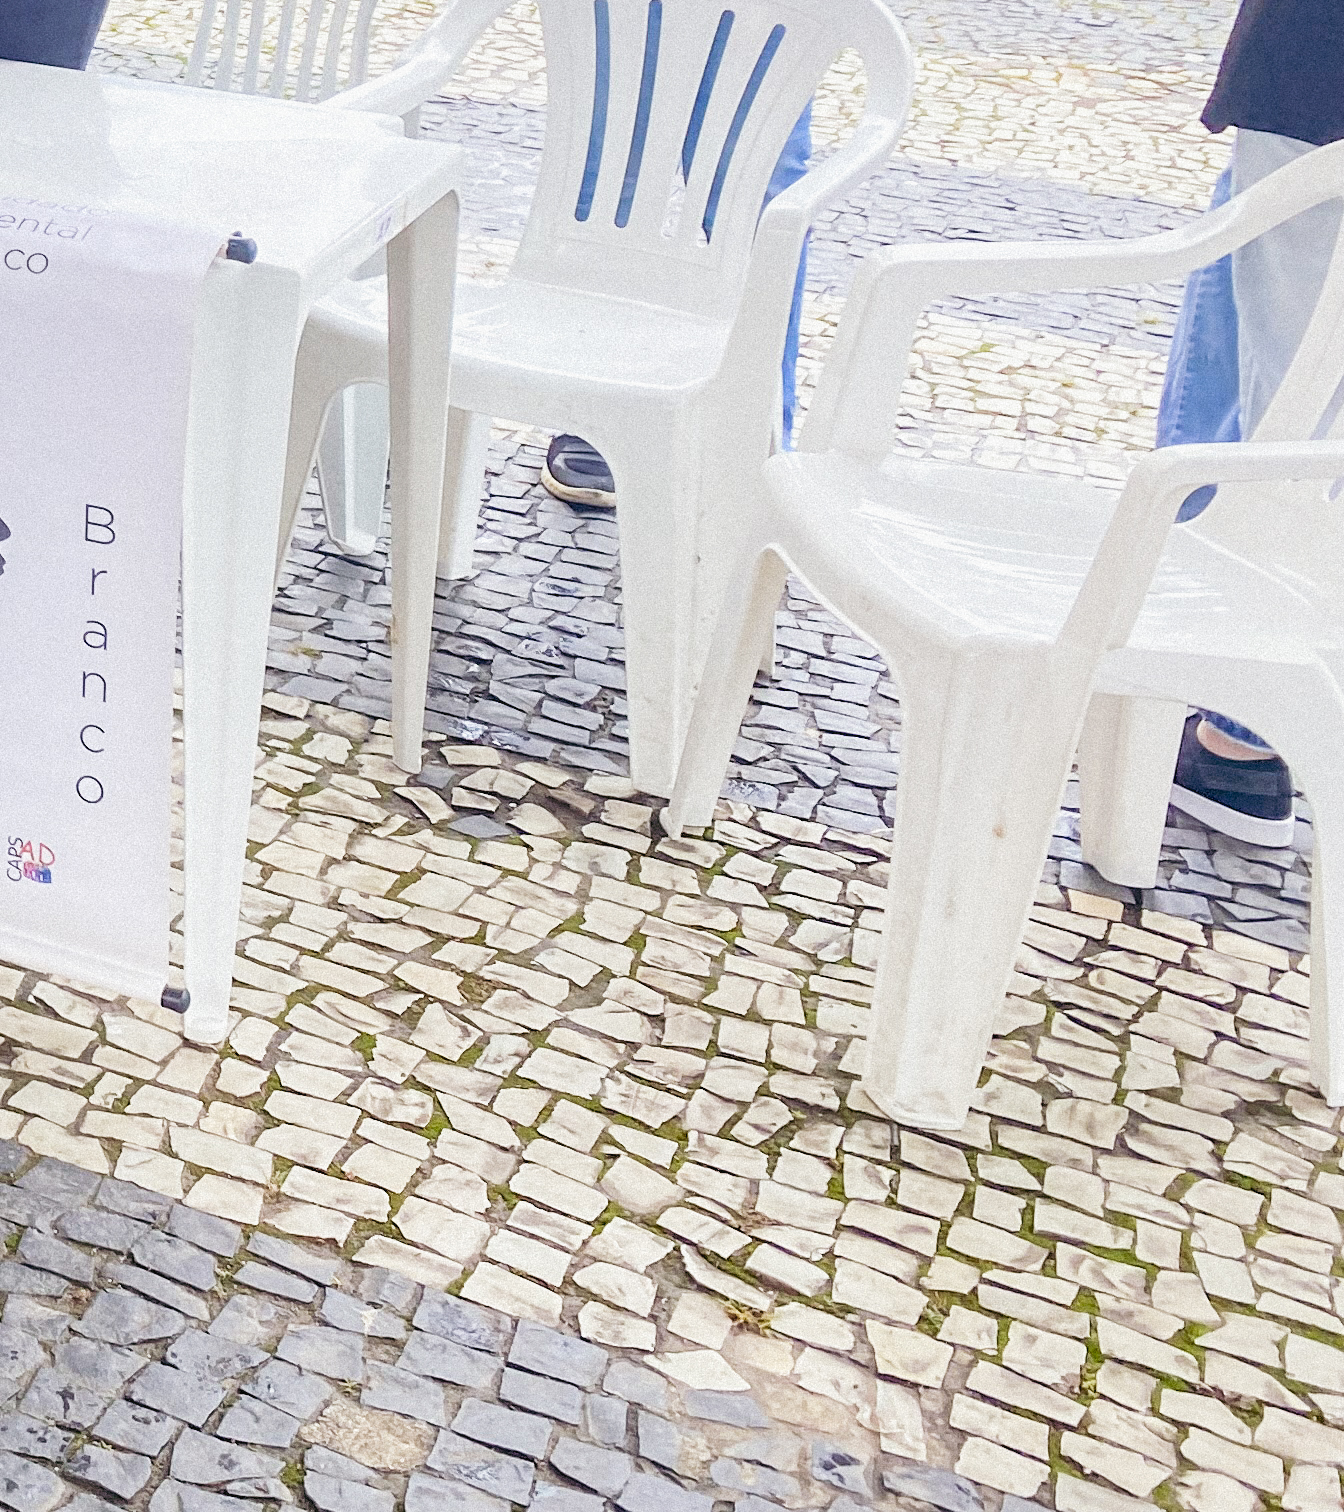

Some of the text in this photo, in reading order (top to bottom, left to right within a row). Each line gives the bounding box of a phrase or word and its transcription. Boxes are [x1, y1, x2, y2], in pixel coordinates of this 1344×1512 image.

[76, 503, 117, 806] Branco
[6, 835, 24, 882] CAPS
[20, 840, 56, 866] AD
